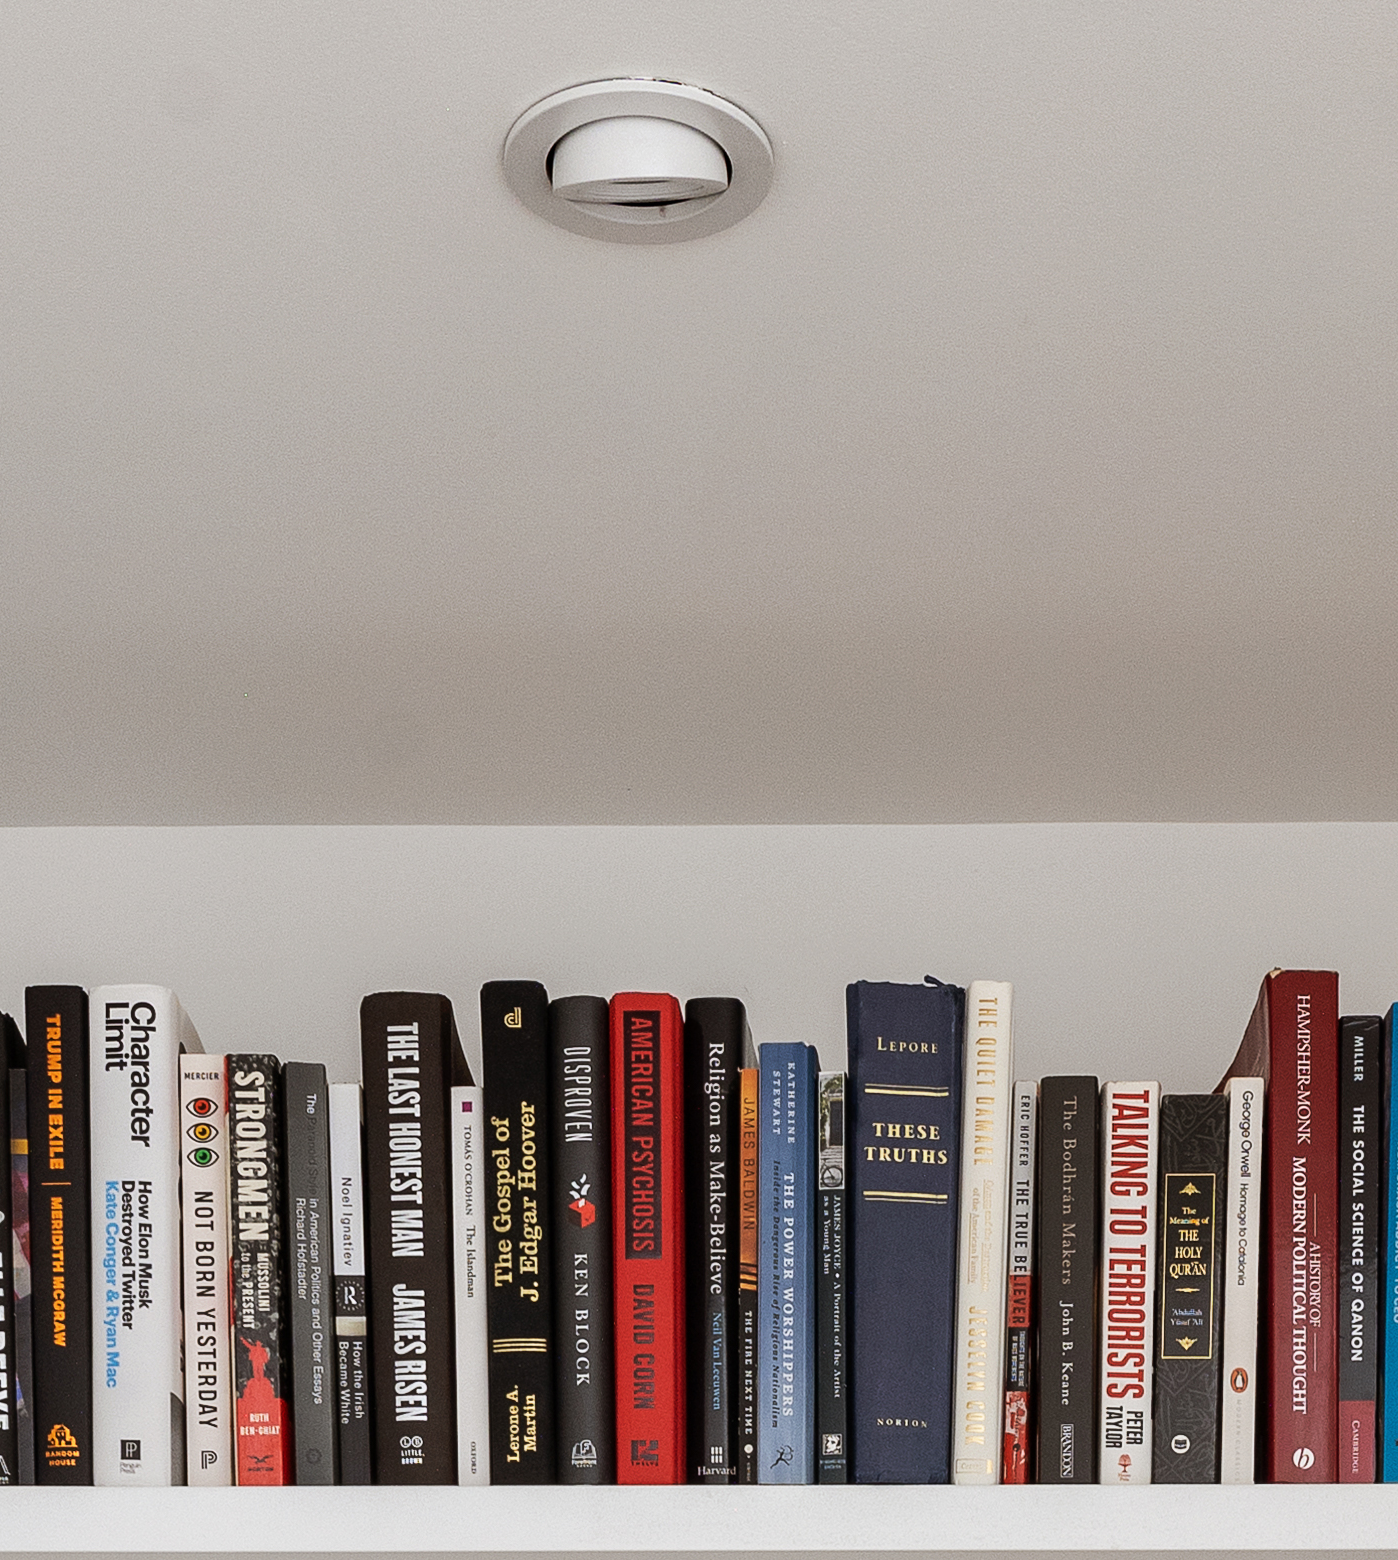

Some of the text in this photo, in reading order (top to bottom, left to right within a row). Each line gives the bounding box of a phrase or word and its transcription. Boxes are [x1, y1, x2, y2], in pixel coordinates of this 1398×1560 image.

[46, 1014, 64, 1169] TRUMP IN EXILE
[104, 1001, 129, 1072] Limit
[129, 1001, 156, 1147] Character
[1295, 995, 1311, 1144] HAMPSHER-MONK
[234, 1071, 269, 1241] STRONGMEN
[387, 1022, 424, 1256] THE LAST HONEST MAN
[630, 1018, 655, 1251] AMERICAN PSYCHOSIS
[864, 1147, 948, 1165] TRUTHS
[873, 1123, 940, 1141] THESE
[120, 1181, 136, 1329] Destroyed Twitter
[138, 1181, 152, 1309] How Elon Musk
[1105, 1091, 1150, 1399] TALKING TO TERRORISTS
[1292, 1156, 1307, 1414] MODERN POLITICAL THOUGHT
[1350, 1106, 1365, 1361] THE SOCIAL SCIENCE OF QANON
[192, 1191, 218, 1428] NOT BORN YESTERDAY
[392, 1284, 428, 1422] JAMES RISEN
[632, 1284, 656, 1409] DAVID CORN
[1105, 1406, 1123, 1448] TAYLOR
[1126, 1411, 1143, 1444] PETER
